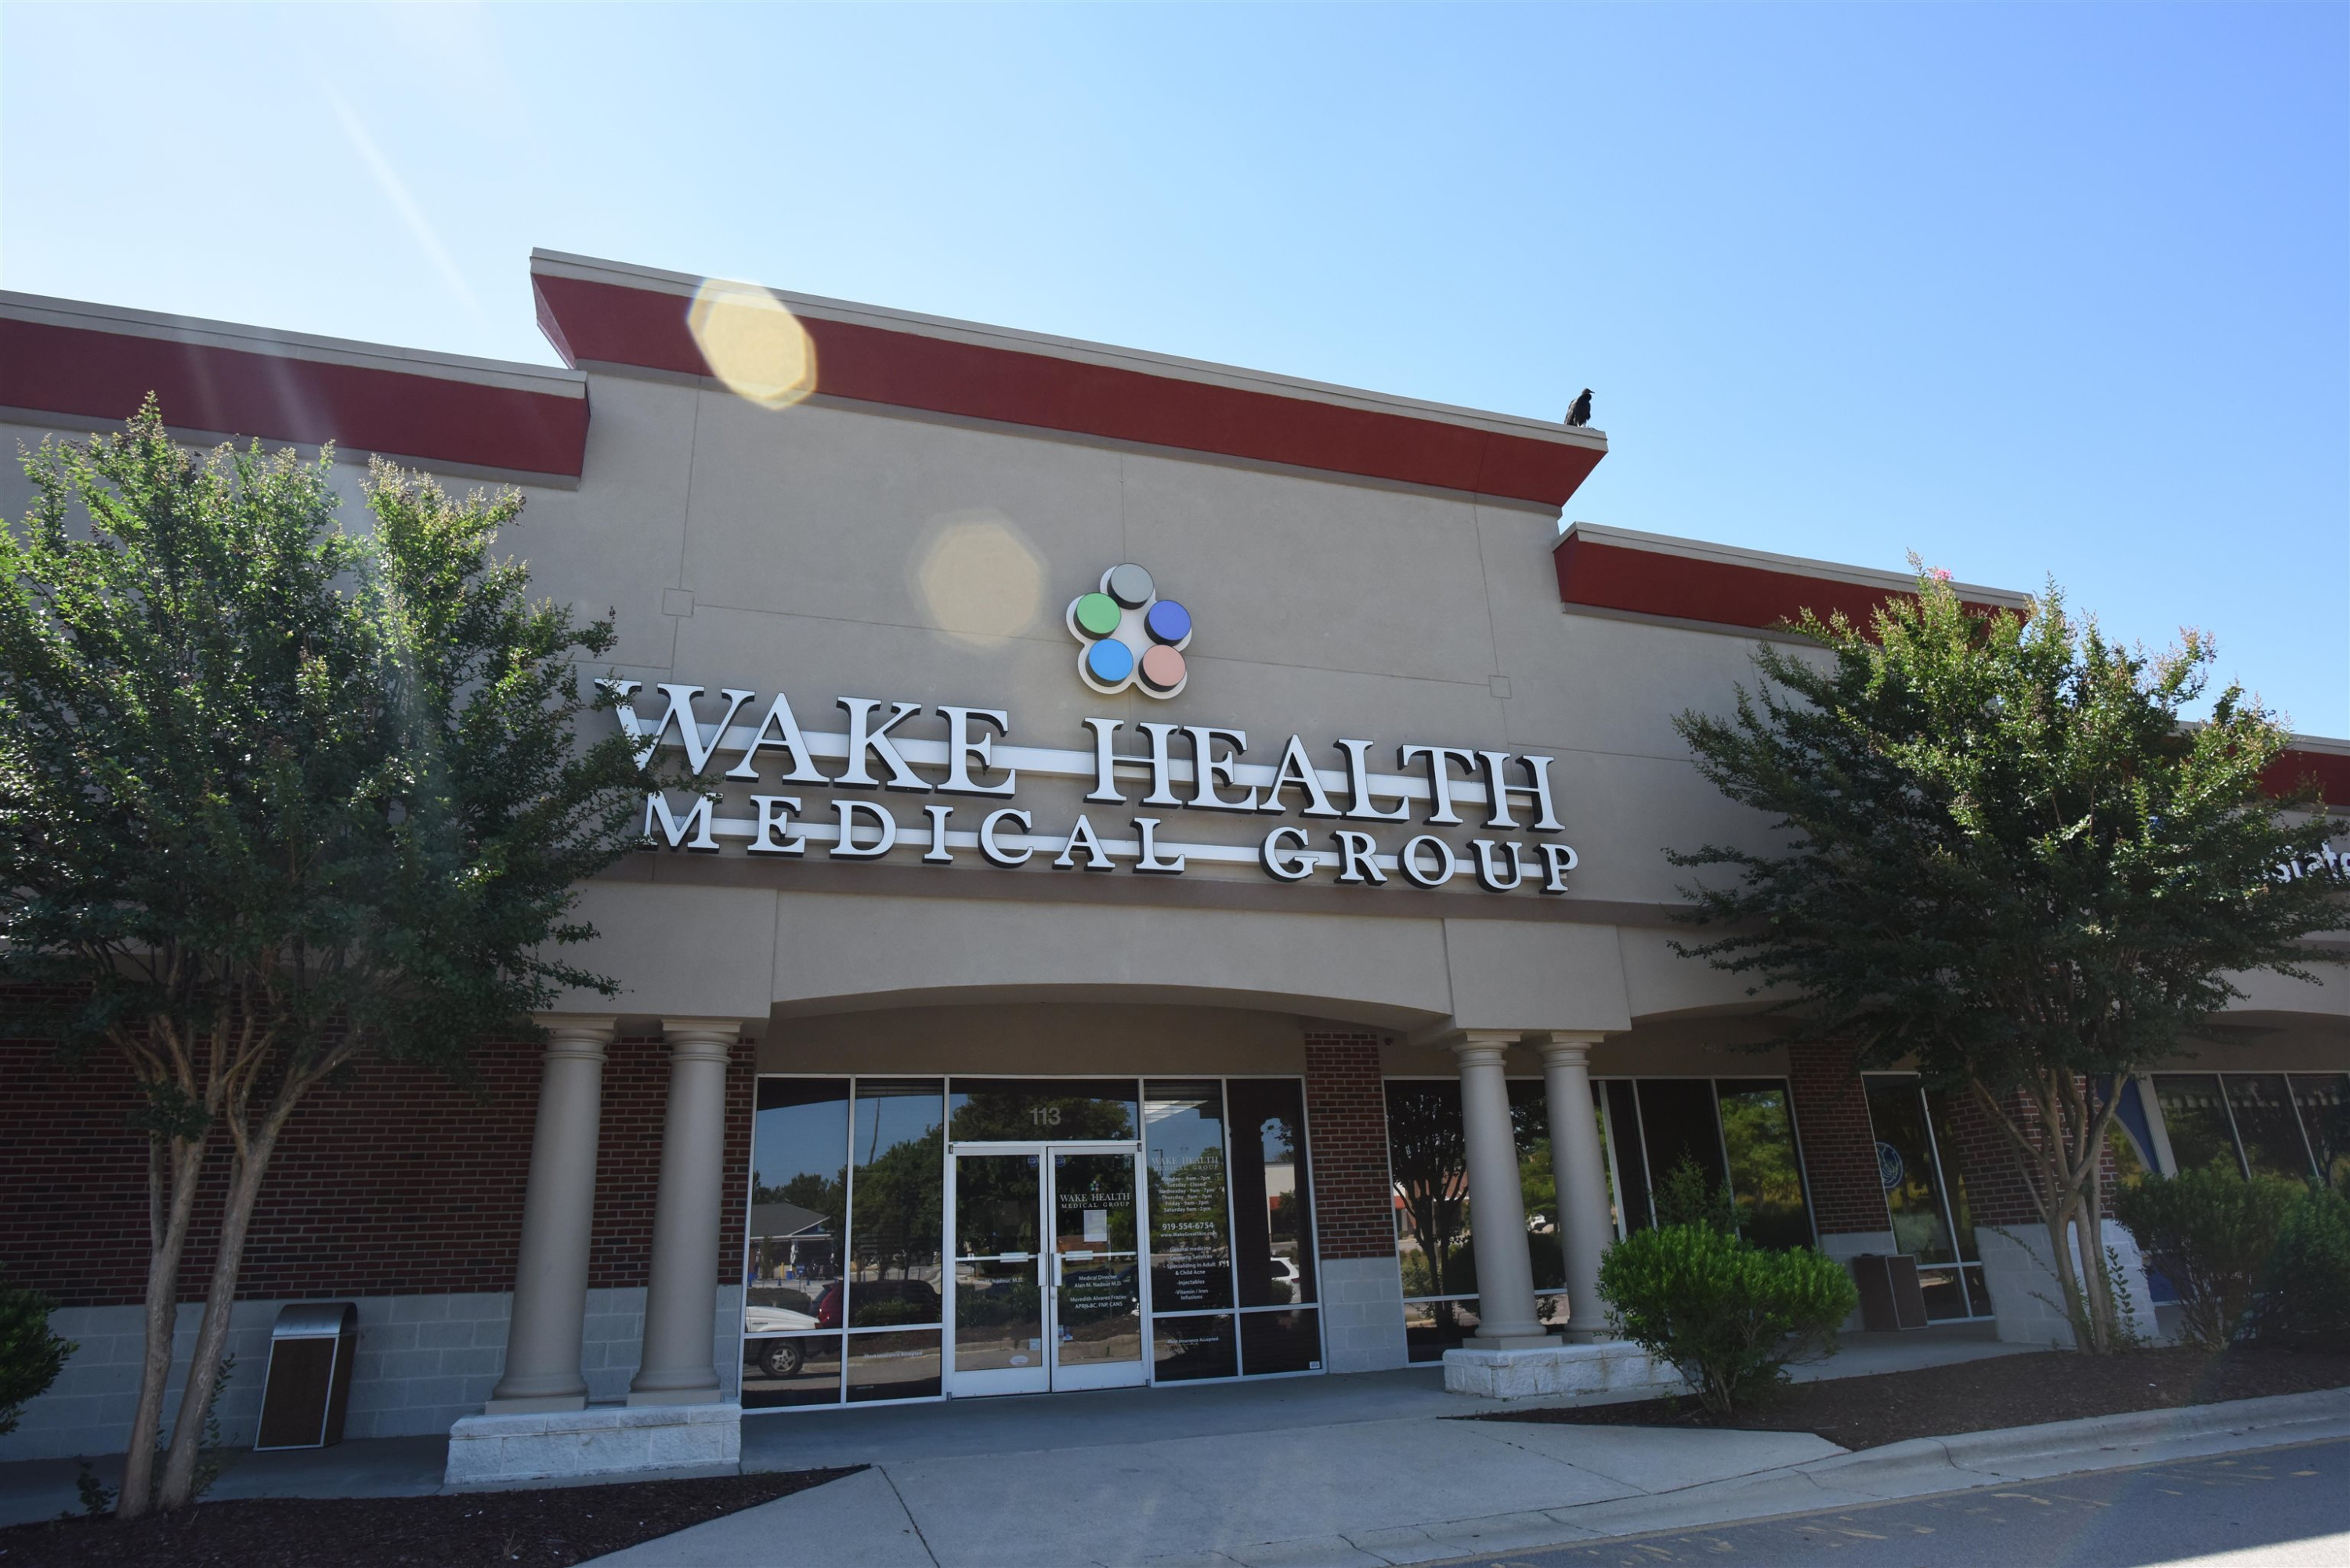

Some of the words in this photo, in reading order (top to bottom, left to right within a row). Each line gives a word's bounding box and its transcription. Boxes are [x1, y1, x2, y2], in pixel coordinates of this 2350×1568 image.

[594, 678, 1016, 797] WAKE
[1082, 717, 1565, 833] HEALTH
[638, 790, 1185, 874] MEDICAL
[1260, 826, 1578, 894] GROUP
[1029, 1107, 1061, 1125] 113
[1182, 1156, 1218, 1165] HEALTH
[1060, 1193, 1087, 1202] WAKE
[1091, 1192, 1130, 1201] HEALTH
[1162, 1222, 1214, 1230] 919-554-6754
